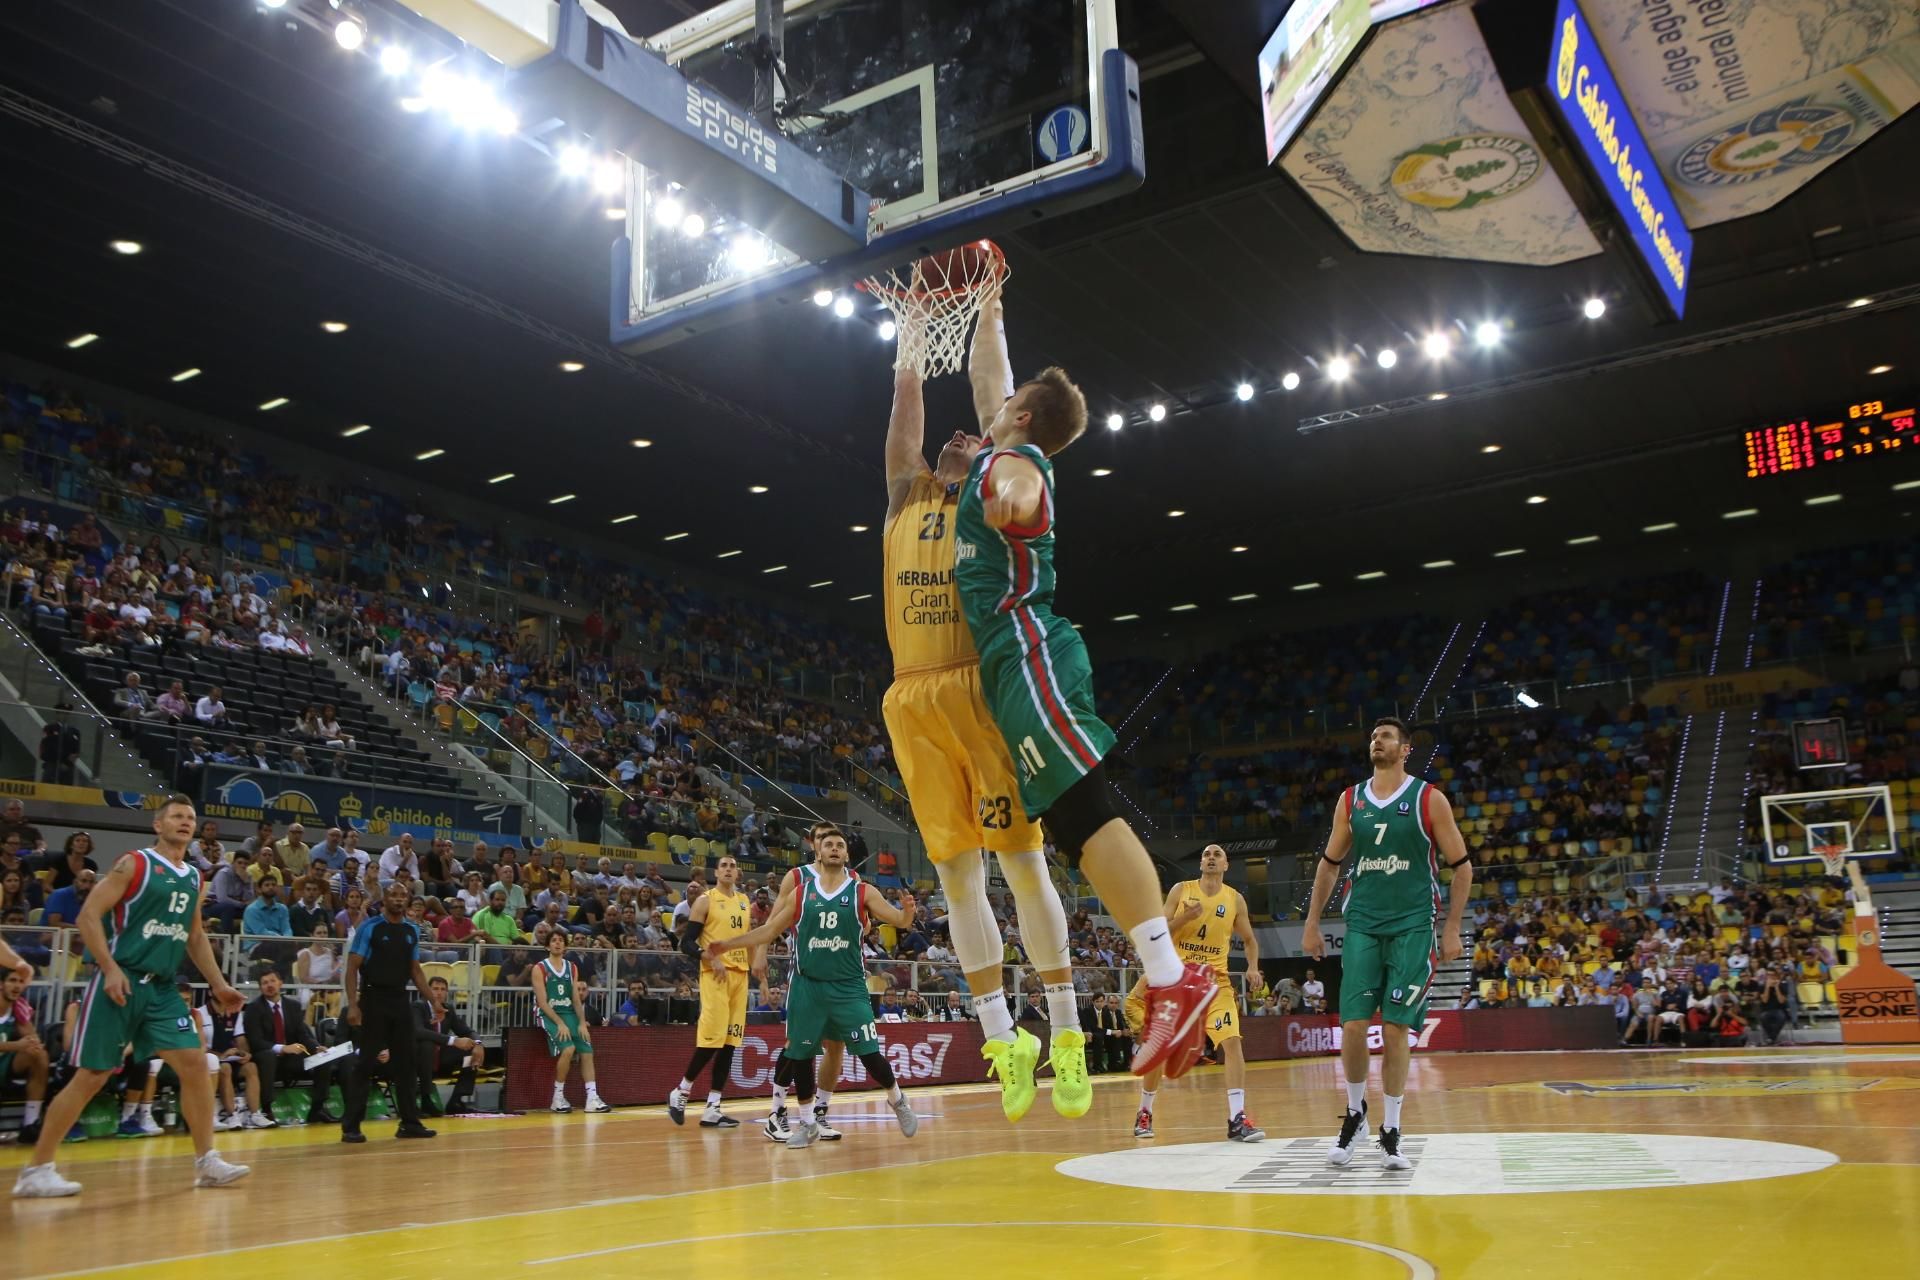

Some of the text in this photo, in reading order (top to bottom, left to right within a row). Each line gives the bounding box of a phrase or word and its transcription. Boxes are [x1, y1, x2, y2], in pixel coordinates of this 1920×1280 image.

[1697, 28, 1750, 103] mineral
[686, 83, 777, 156] Schelde
[686, 103, 777, 174] Sports
[1459, 137, 1522, 154] AGUA
[1575, 65, 1685, 291] Cabildo de Gran Canaria
[918, 511, 946, 541] 23
[910, 588, 949, 608] Gran
[902, 603, 961, 626] Canaria
[204, 803, 264, 821] GRAN CANARIA
[373, 805, 453, 829] Cabildo de
[982, 796, 1013, 830] 23
[1374, 823, 1388, 846] 7
[169, 891, 190, 914] 13
[730, 915, 743, 930] 34
[818, 911, 838, 929] 18
[1196, 924, 1207, 941] 4
[1178, 941, 1221, 956] HERBALIFE
[1405, 984, 1421, 1007] 7
[1839, 989, 1915, 1005] SPORT
[1222, 1012, 1232, 1027] 4
[1840, 1004, 1918, 1018] ZONE
[860, 1021, 877, 1042] 18
[1287, 1018, 1443, 1054] Canaras7
